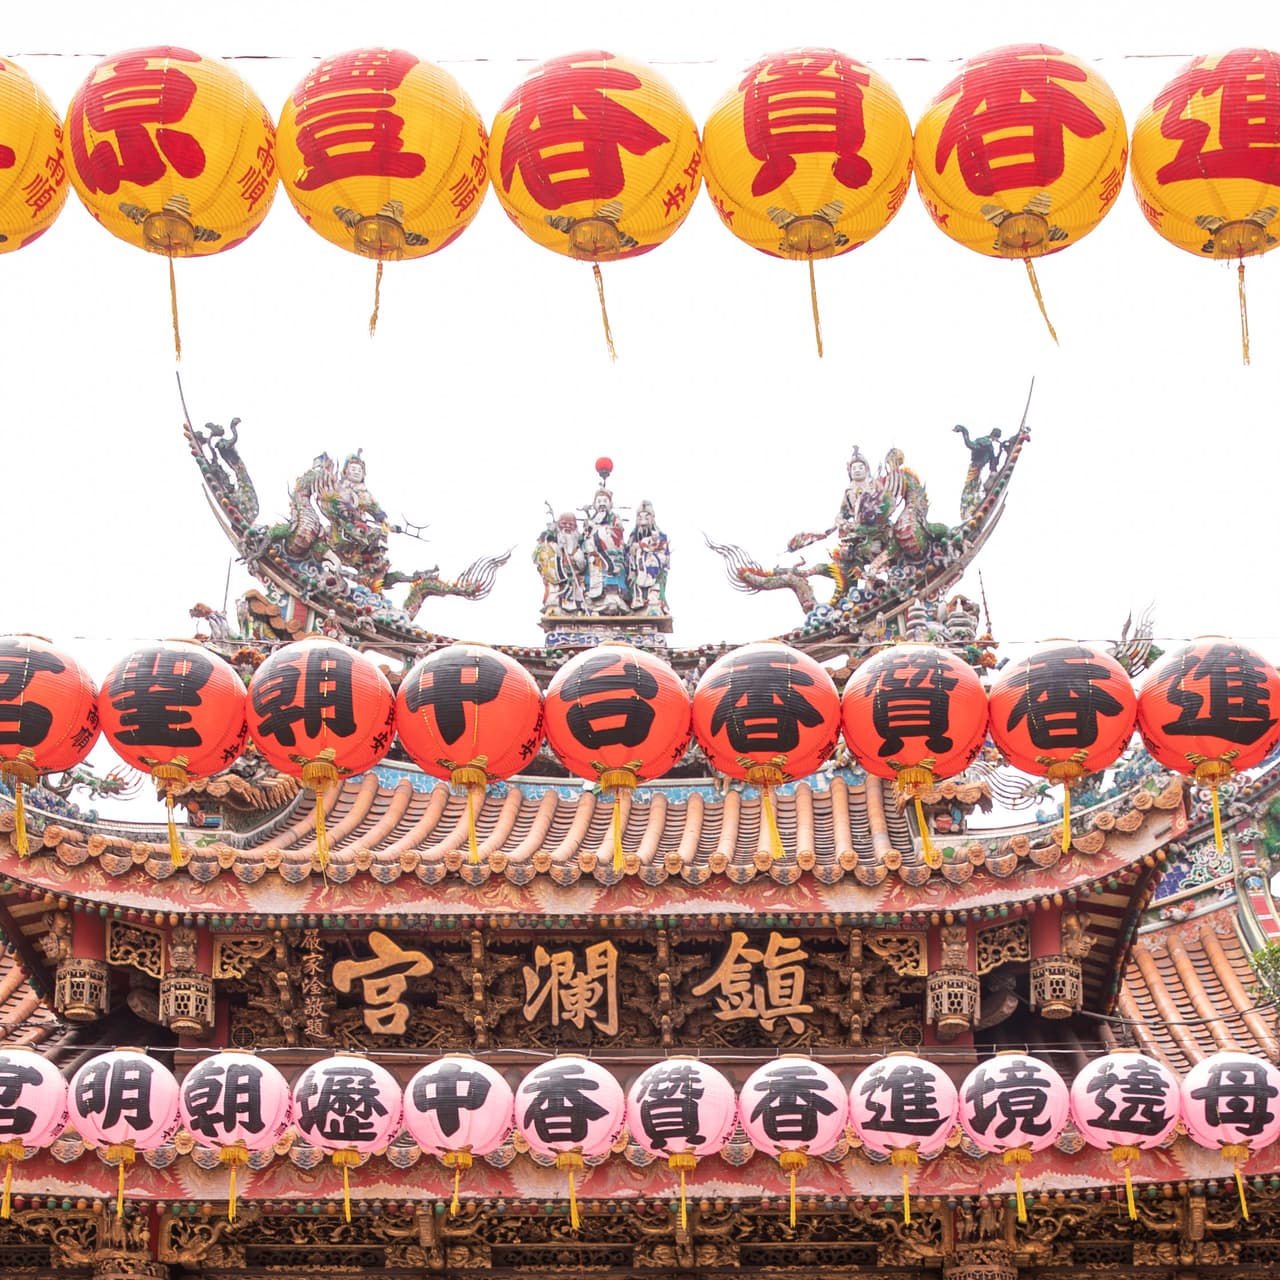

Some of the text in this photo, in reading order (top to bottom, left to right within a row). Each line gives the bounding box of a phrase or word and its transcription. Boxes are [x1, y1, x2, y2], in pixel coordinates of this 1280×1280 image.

[69, 45, 206, 196] 原
[497, 49, 670, 211] 香
[931, 43, 1106, 197] 香
[108, 647, 213, 747] 聖
[252, 647, 356, 747] 朝
[559, 653, 659, 750] 台
[710, 651, 824, 753] 香
[1006, 646, 1124, 750] 香
[1158, 641, 1278, 745] 進
[332, 930, 814, 1036] 鎮瀾宮
[75, 1059, 154, 1132] 明
[184, 1060, 266, 1138] 朝
[296, 1066, 389, 1141] 壢
[413, 1063, 492, 1138] 中
[524, 1064, 610, 1144] 香
[751, 1066, 838, 1142] 香
[860, 1064, 950, 1137] 進
[967, 1060, 1053, 1139] 境
[1191, 1061, 1279, 1136] 母
